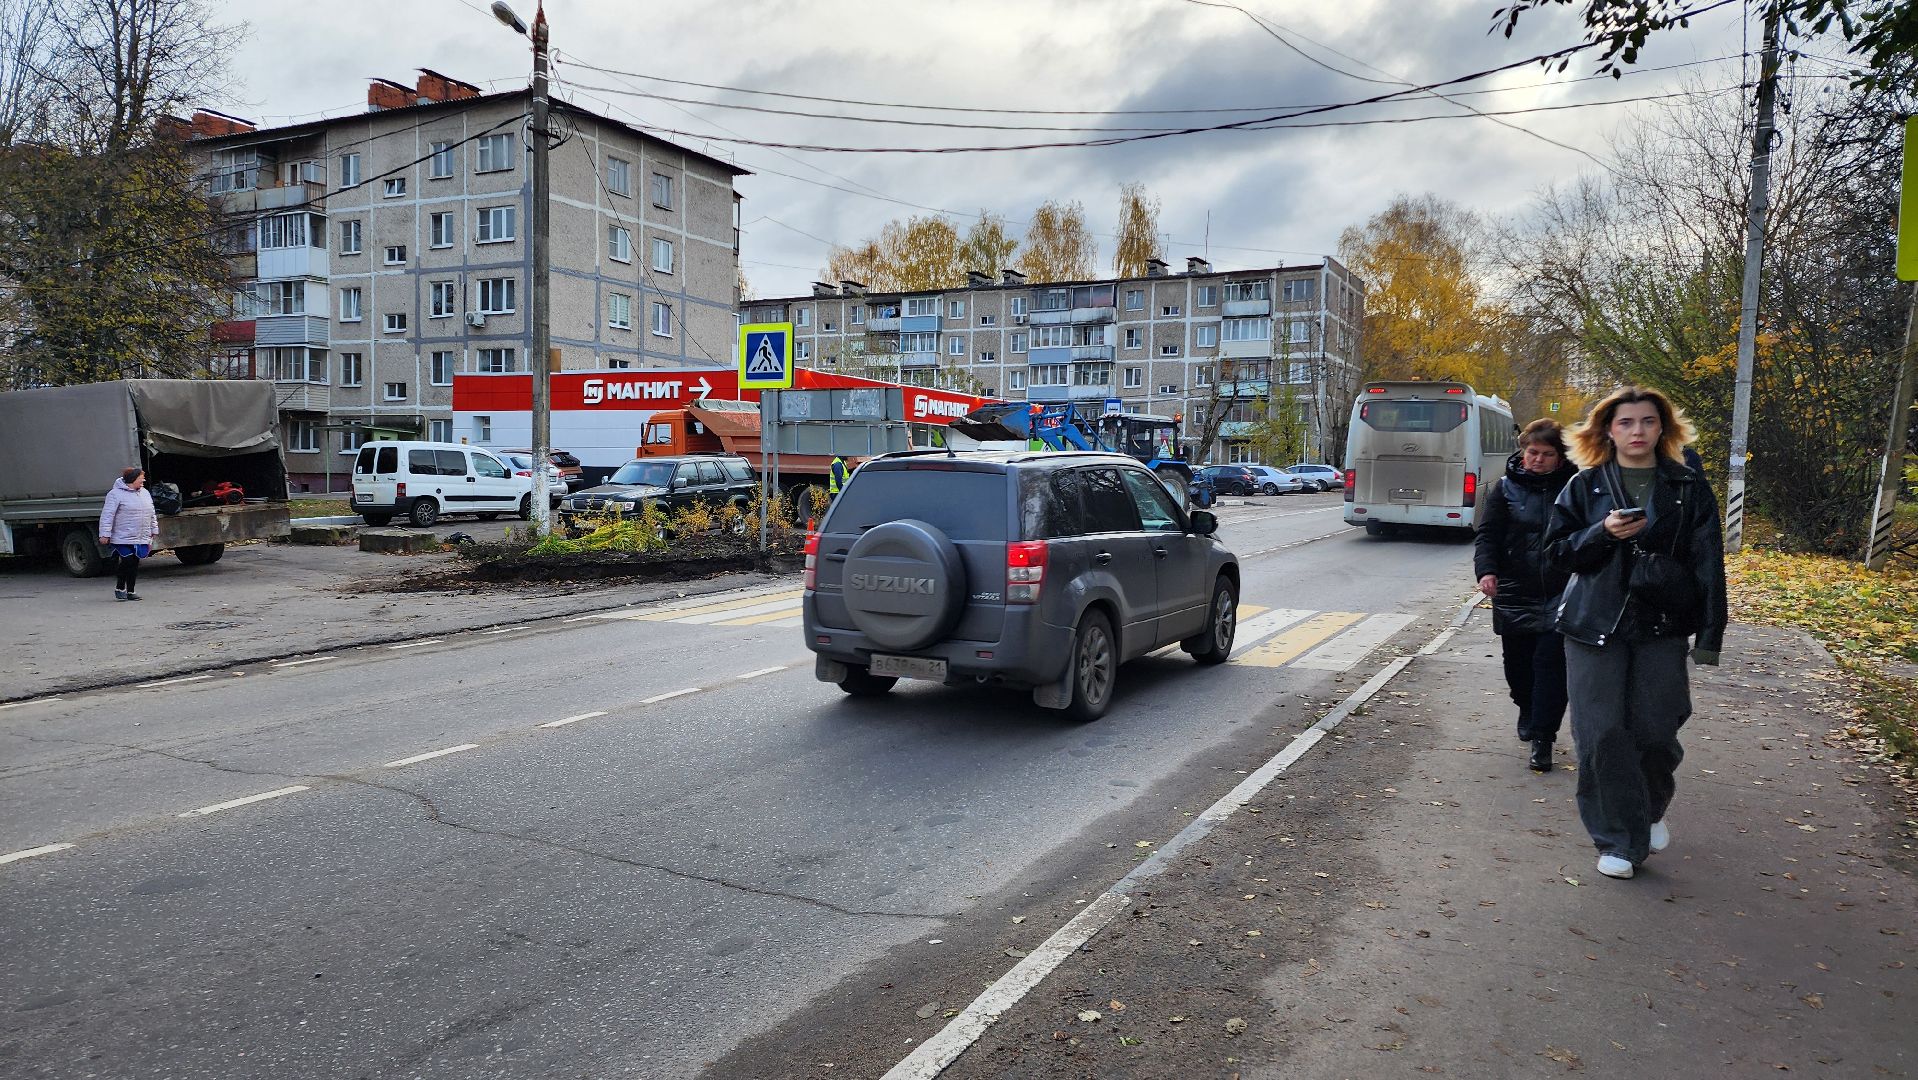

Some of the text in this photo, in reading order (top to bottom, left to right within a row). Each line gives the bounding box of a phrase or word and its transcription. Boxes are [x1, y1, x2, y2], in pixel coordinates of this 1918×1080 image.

[607, 381, 682, 400] МАГНИТ
[927, 398, 970, 417] МАГНИТ
[850, 573, 935, 595] SUZUKI
